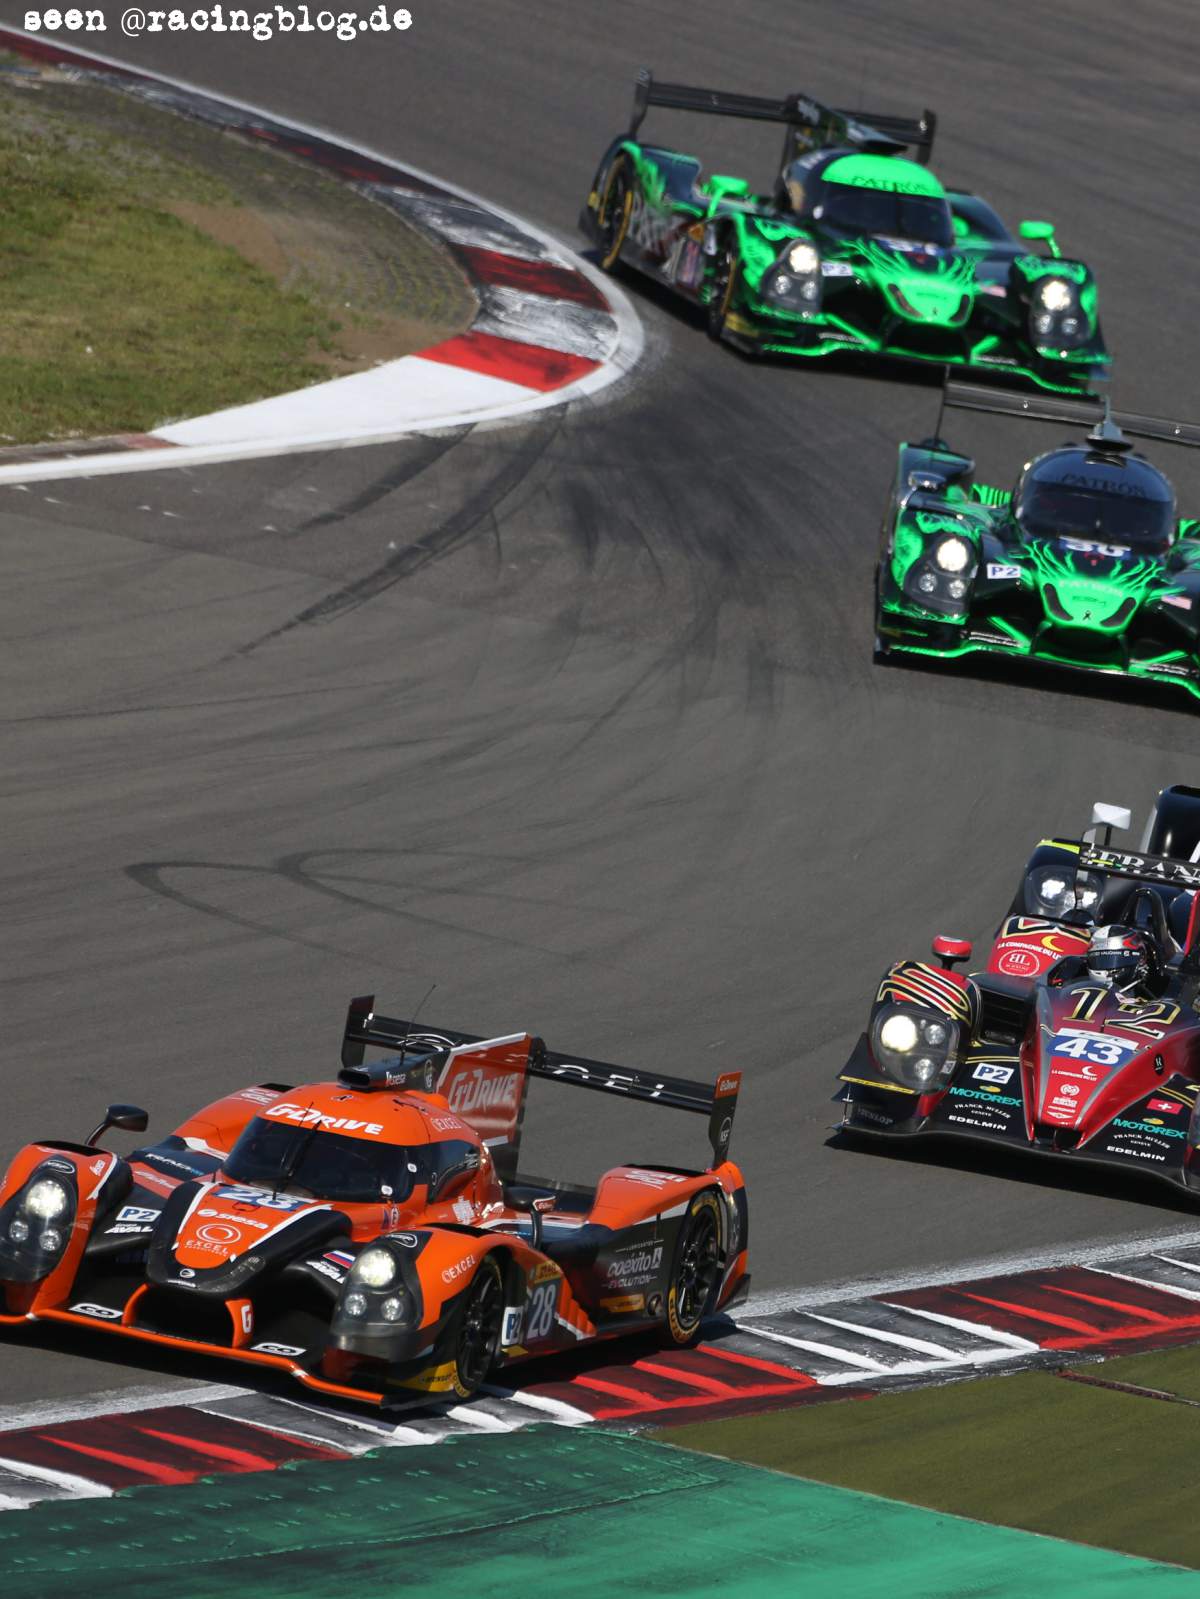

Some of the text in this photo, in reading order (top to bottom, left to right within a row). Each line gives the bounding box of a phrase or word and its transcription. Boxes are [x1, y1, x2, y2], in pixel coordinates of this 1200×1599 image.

[990, 565, 1019, 578] P2
[1054, 1037, 1123, 1065] 43
[976, 1065, 1009, 1081] P2
[949, 1087, 1023, 1107] MOTOREX
[948, 1114, 1007, 1131] EDELMIN
[1112, 1118, 1186, 1139] MOTOREX
[1106, 1145, 1166, 1162] EDELMIN
[121, 1207, 157, 1220] P2
[185, 1239, 229, 1254] EXCEL
[450, 1254, 476, 1280] EXCEL
[608, 1275, 650, 1290] EVOLUTION
[527, 1284, 557, 1341] 28
